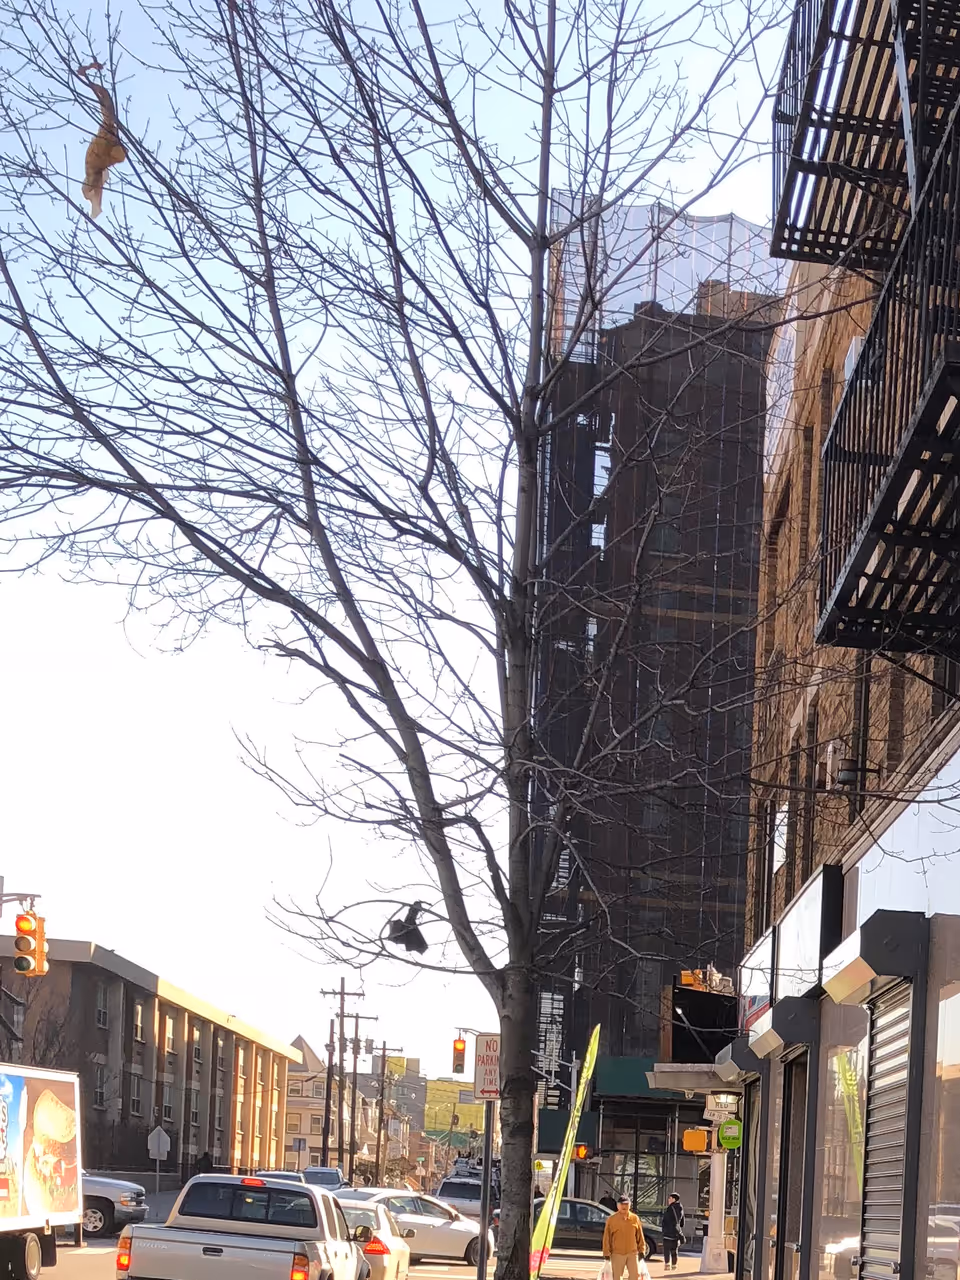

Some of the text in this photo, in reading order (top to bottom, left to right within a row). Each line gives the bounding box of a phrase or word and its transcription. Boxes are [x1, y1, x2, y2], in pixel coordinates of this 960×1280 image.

[485, 1040, 498, 1052] NO
[477, 1055, 500, 1067] PARKIN
[484, 1068, 497, 1077] ANY
[483, 1078, 497, 1086] TIME
